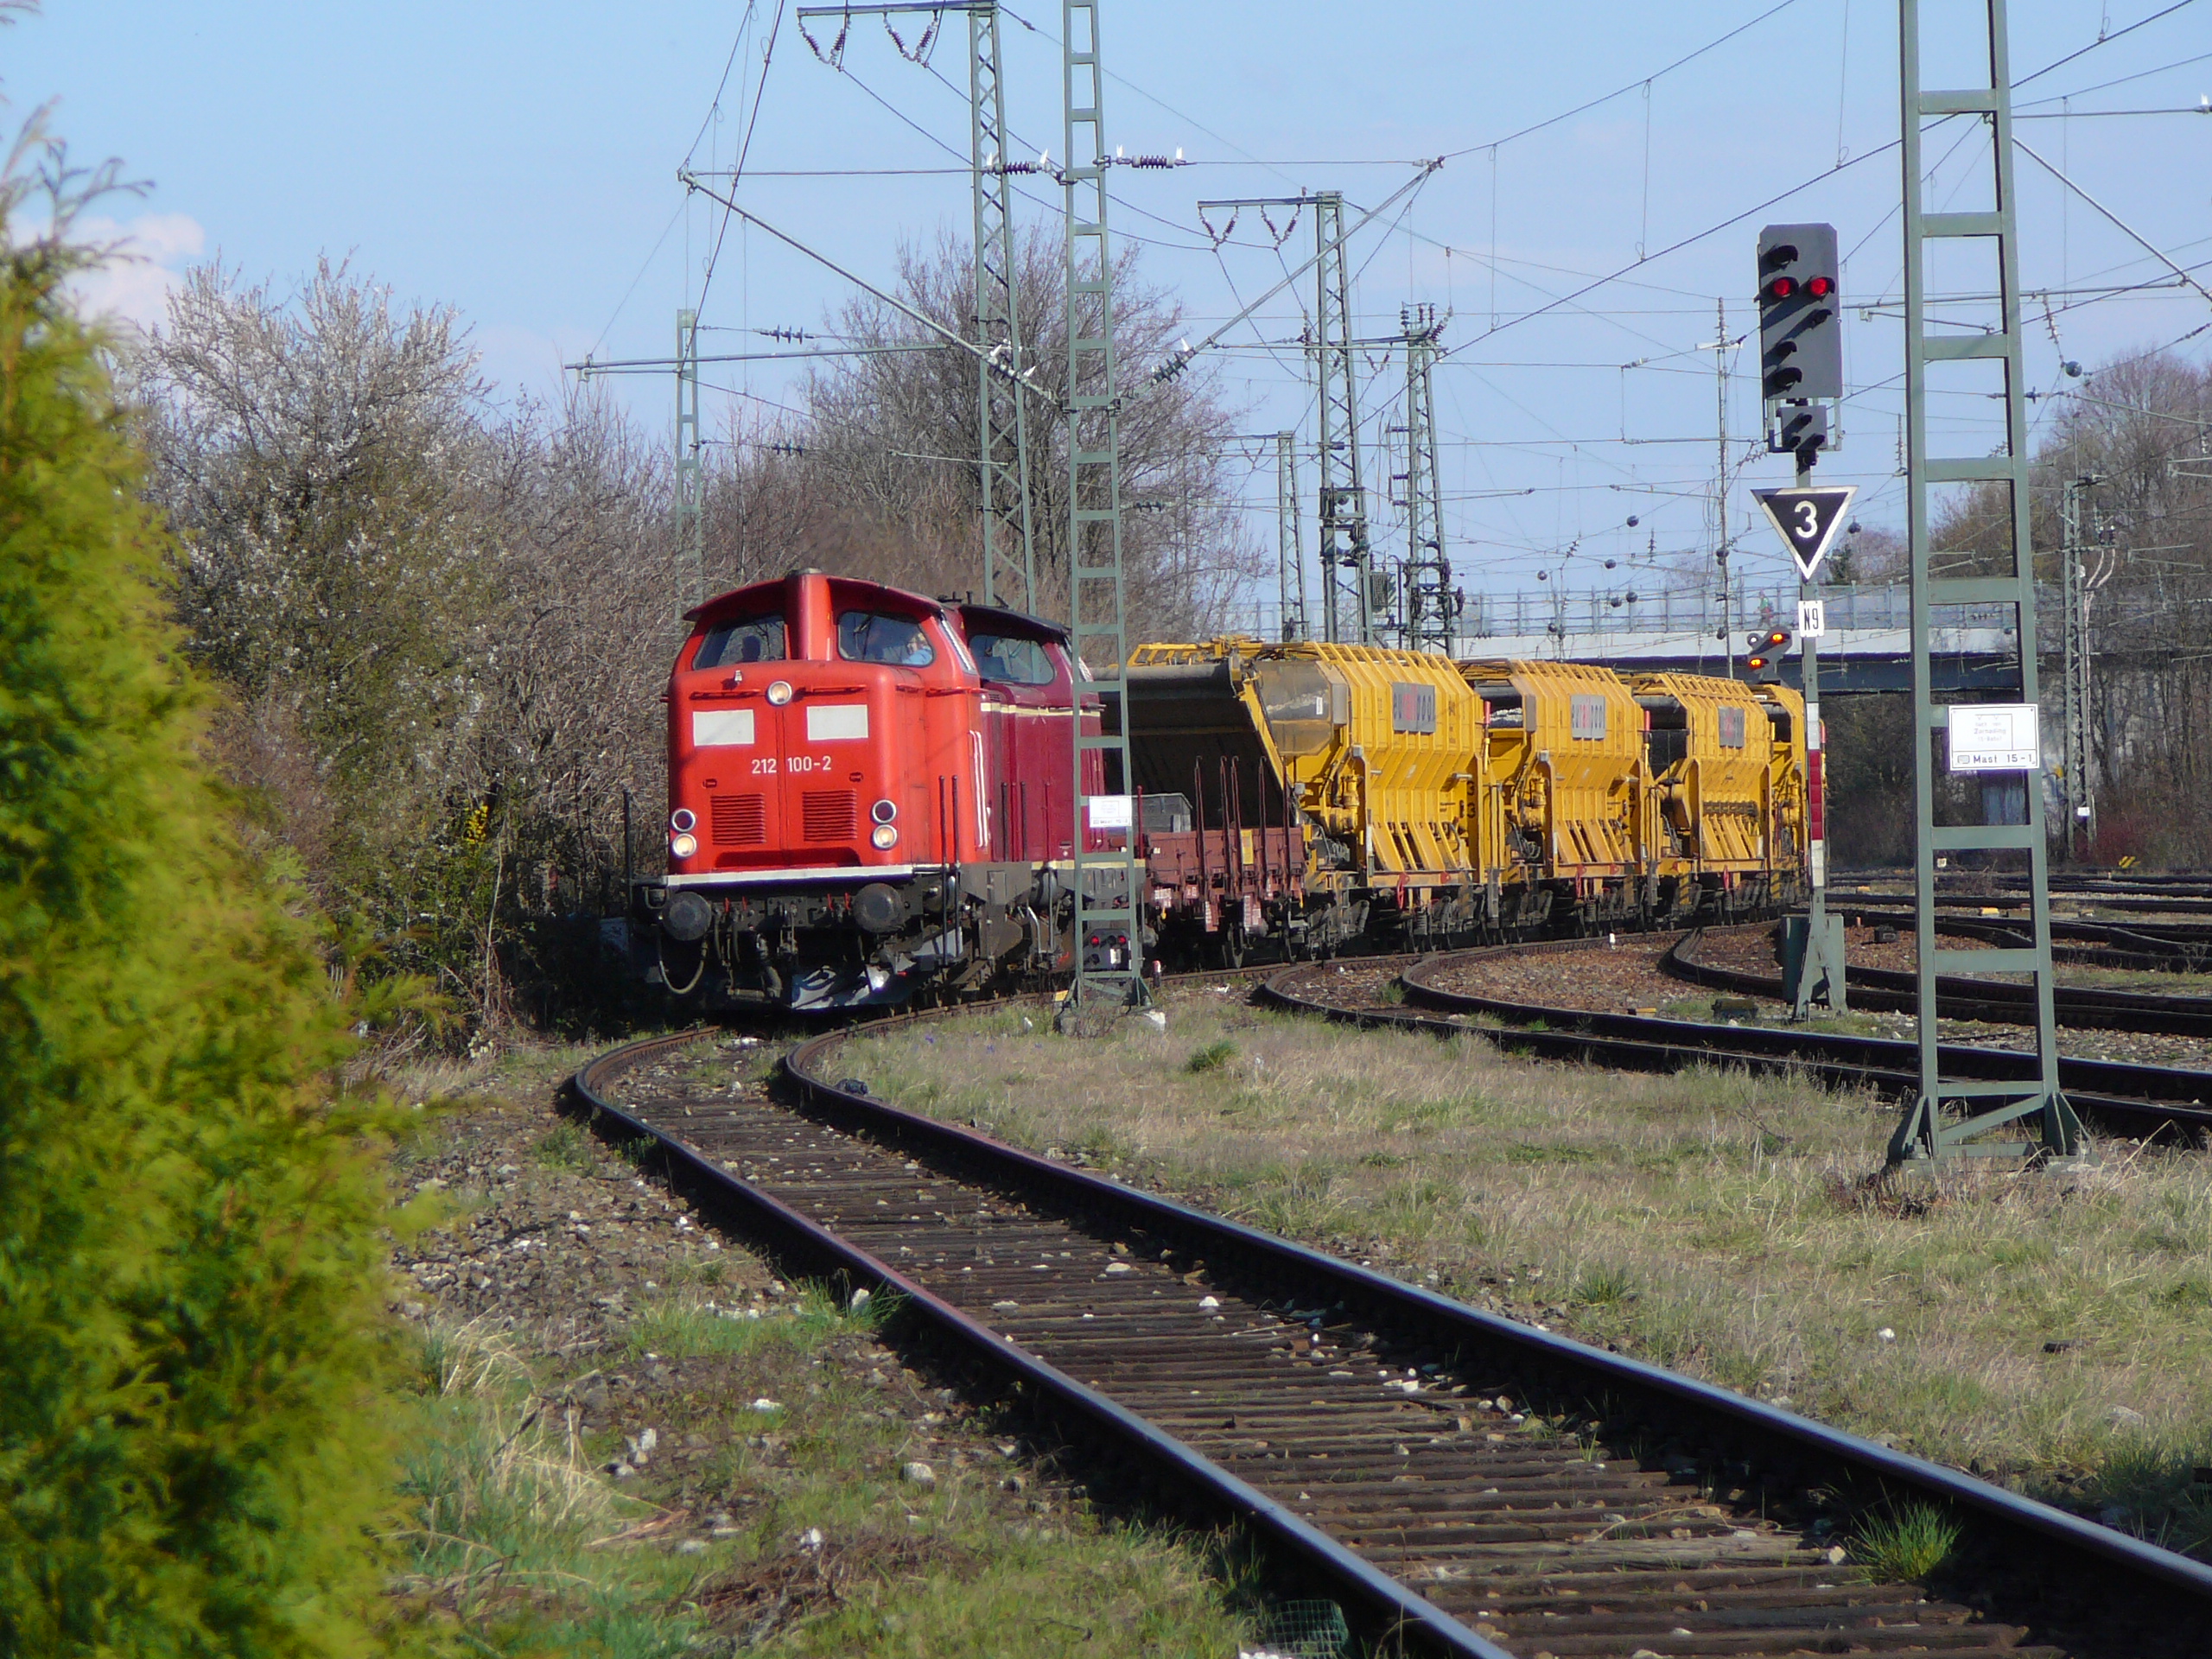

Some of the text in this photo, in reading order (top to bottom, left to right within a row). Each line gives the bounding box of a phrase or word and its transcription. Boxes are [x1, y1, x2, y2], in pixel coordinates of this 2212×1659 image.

[1795, 500, 1818, 538] 3
[1803, 607, 1819, 631] N9
[751, 755, 831, 774] 212 100-2
[1973, 754, 1998, 764] Mast
